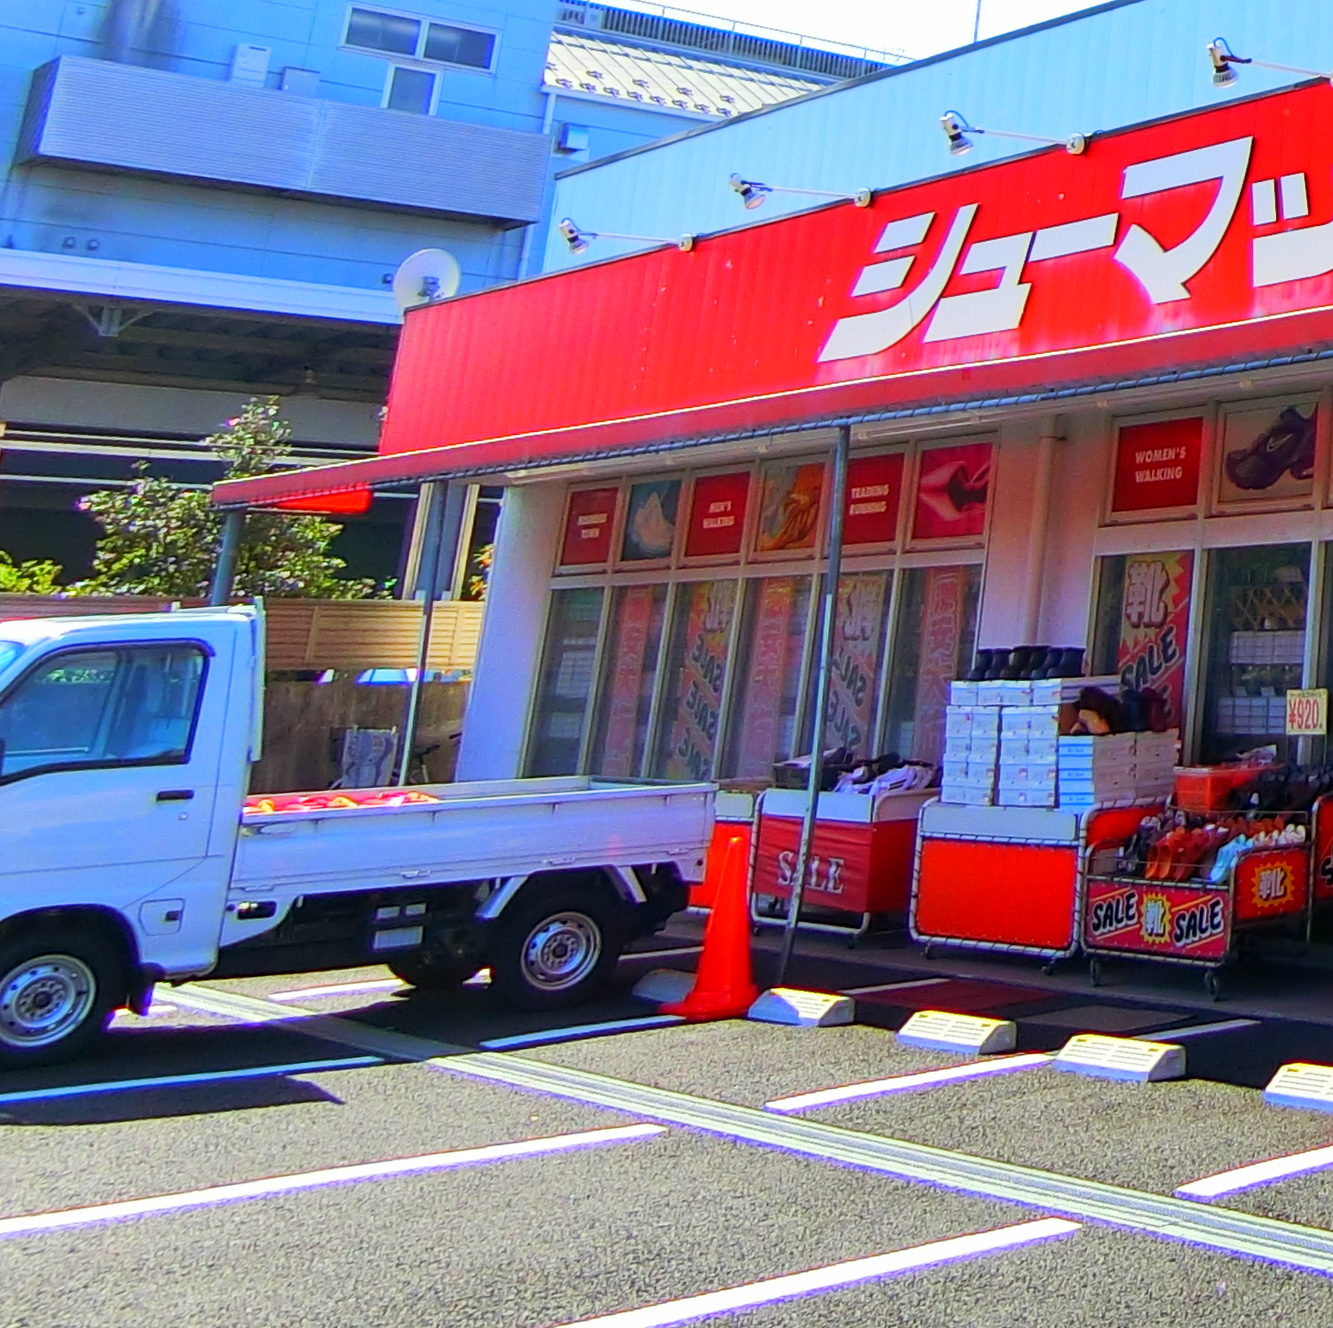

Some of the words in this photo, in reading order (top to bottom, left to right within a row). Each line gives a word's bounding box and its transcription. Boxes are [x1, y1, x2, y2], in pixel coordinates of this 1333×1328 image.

[1135, 446, 1187, 465] WOMEN'S
[1135, 466, 1183, 483] WALKING
[1125, 560, 1170, 629] 靴
[778, 851, 845, 894] SLE
[1091, 890, 1138, 936] SALE
[1173, 896, 1224, 948] SALE
